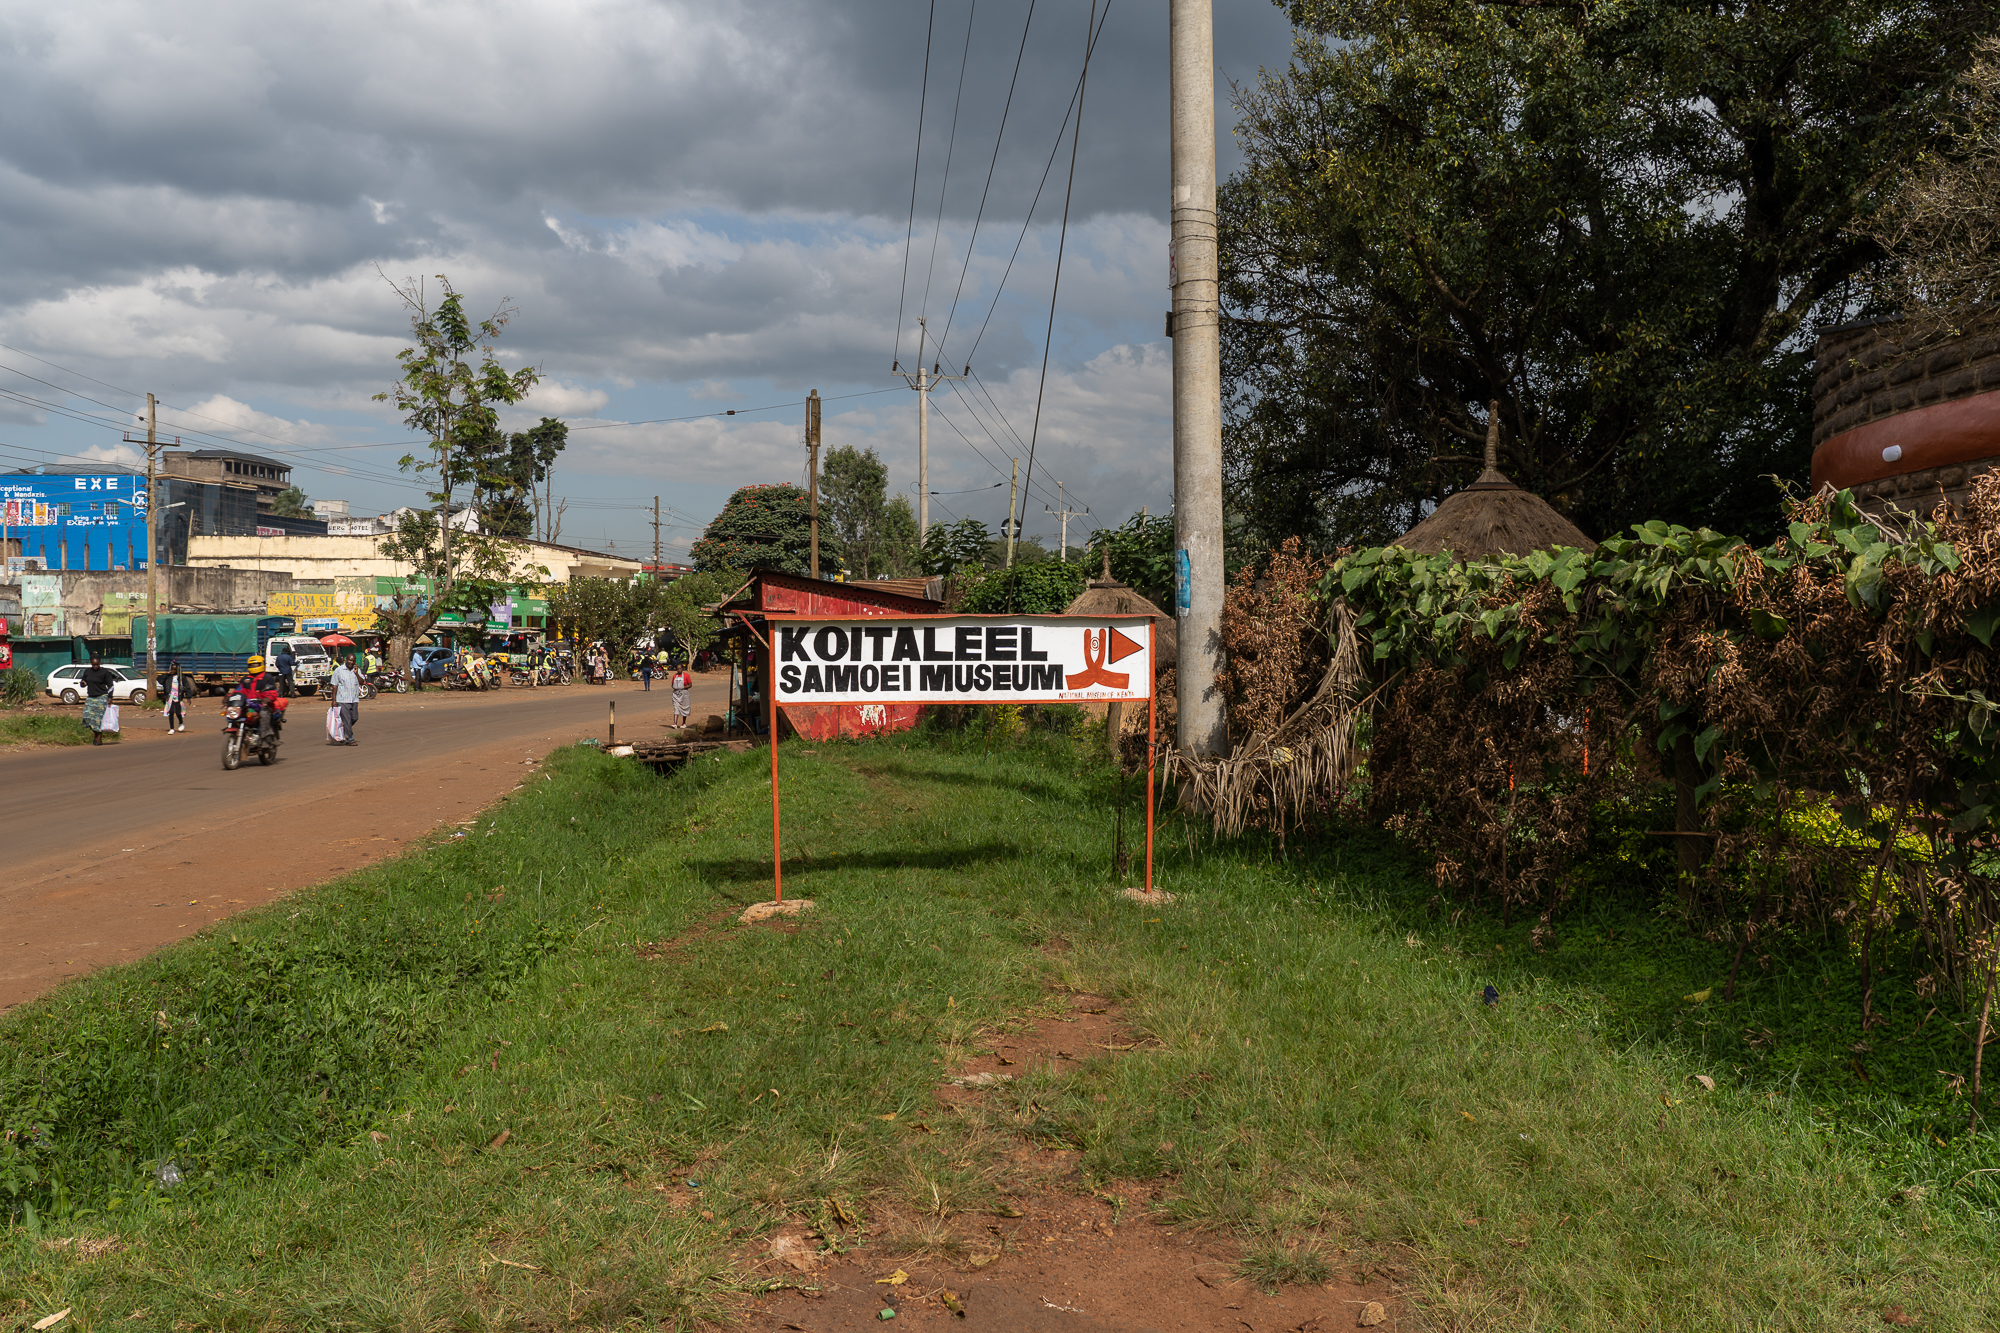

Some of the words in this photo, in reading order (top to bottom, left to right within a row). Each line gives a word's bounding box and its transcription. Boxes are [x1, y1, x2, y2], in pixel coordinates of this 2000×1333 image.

[0, 485, 33, 493] ceptional
[75, 478, 118, 490] EXE
[287, 594, 316, 608] KENYA
[319, 595, 341, 608] SEE
[780, 625, 1048, 662] KOITALEEL
[779, 663, 912, 694] SAMOEI
[919, 663, 1064, 693] MUSEUM
